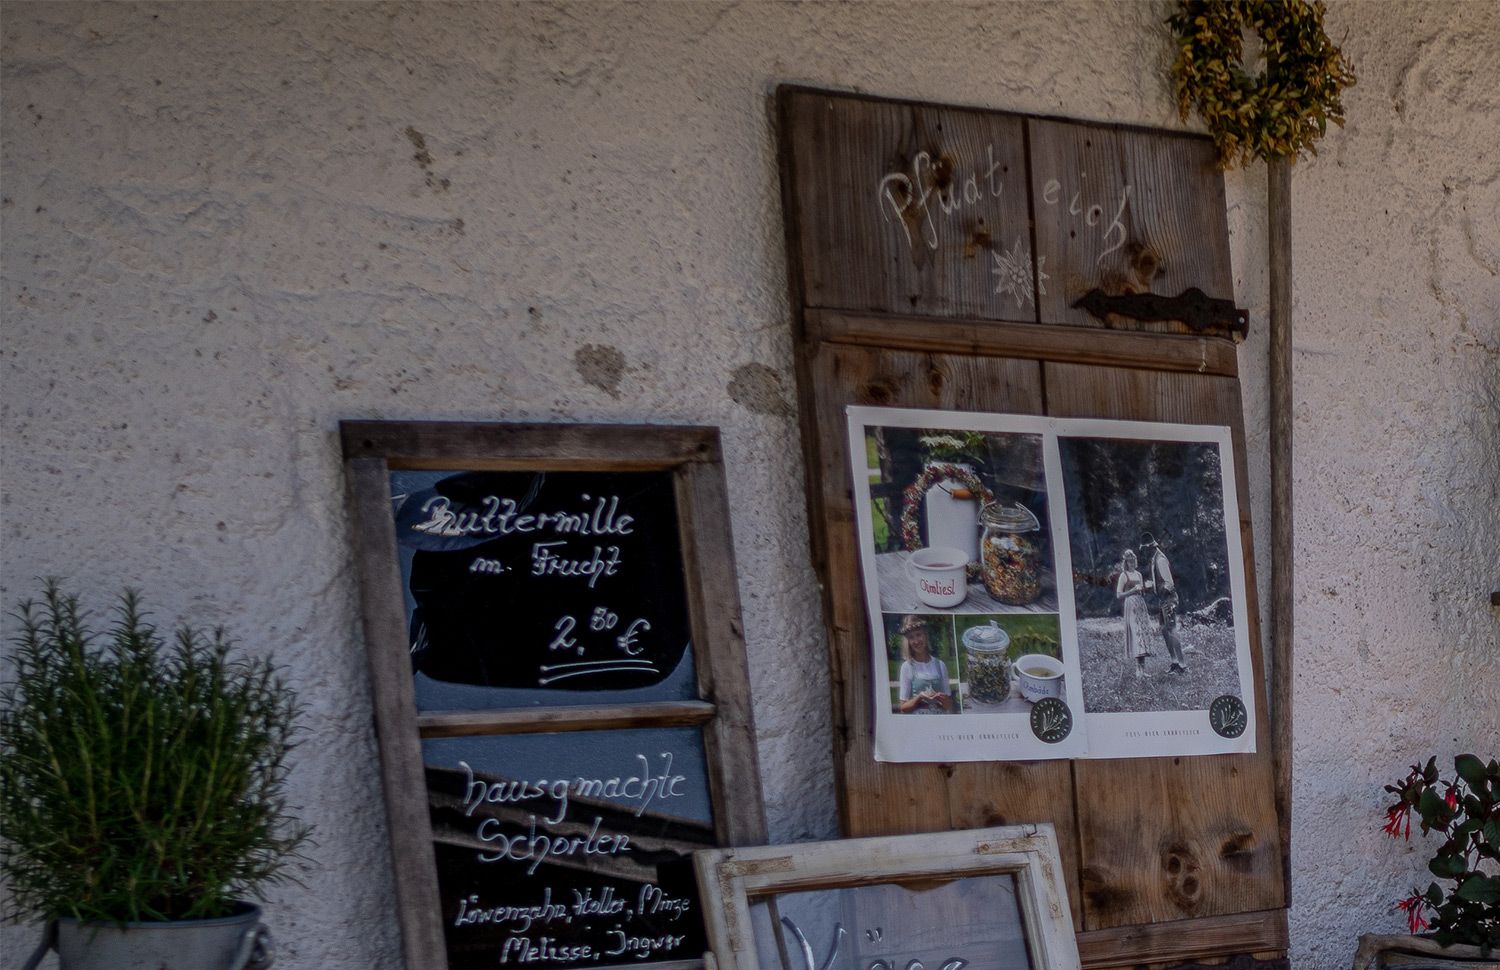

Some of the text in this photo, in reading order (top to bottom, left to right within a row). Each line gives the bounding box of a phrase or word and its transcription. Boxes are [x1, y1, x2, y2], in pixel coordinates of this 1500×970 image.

[531, 540, 623, 588] Frucht
[458, 752, 687, 824] hausgmachte
[477, 815, 632, 875] Schorlen
[637, 884, 691, 921] Minze
